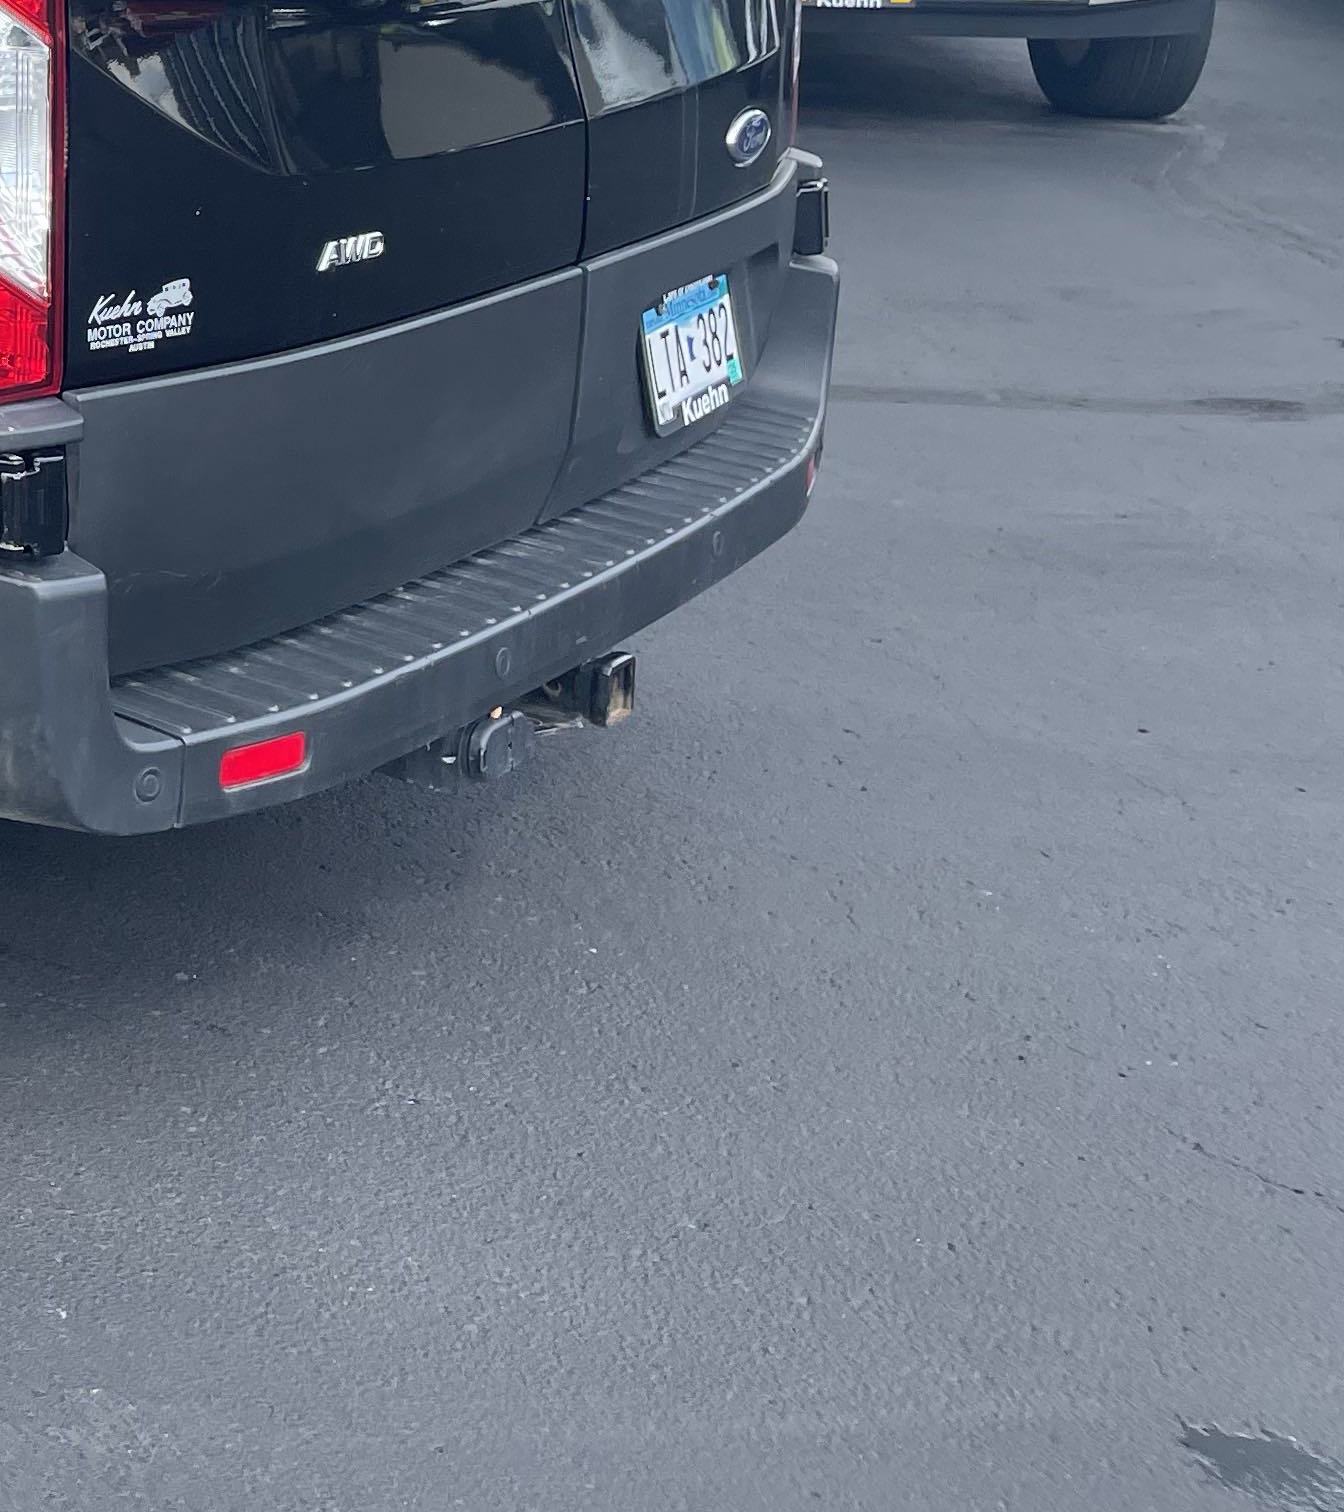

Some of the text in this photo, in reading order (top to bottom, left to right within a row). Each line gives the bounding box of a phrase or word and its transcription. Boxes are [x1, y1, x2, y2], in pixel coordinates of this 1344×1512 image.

[315, 231, 385, 271] AWD
[88, 290, 142, 325] Kuehn
[87, 312, 194, 342] MOTOR COMPANY
[128, 341, 155, 353] AUSTIN
[648, 303, 734, 399] LTA 382
[680, 383, 730, 426] Kuehn
